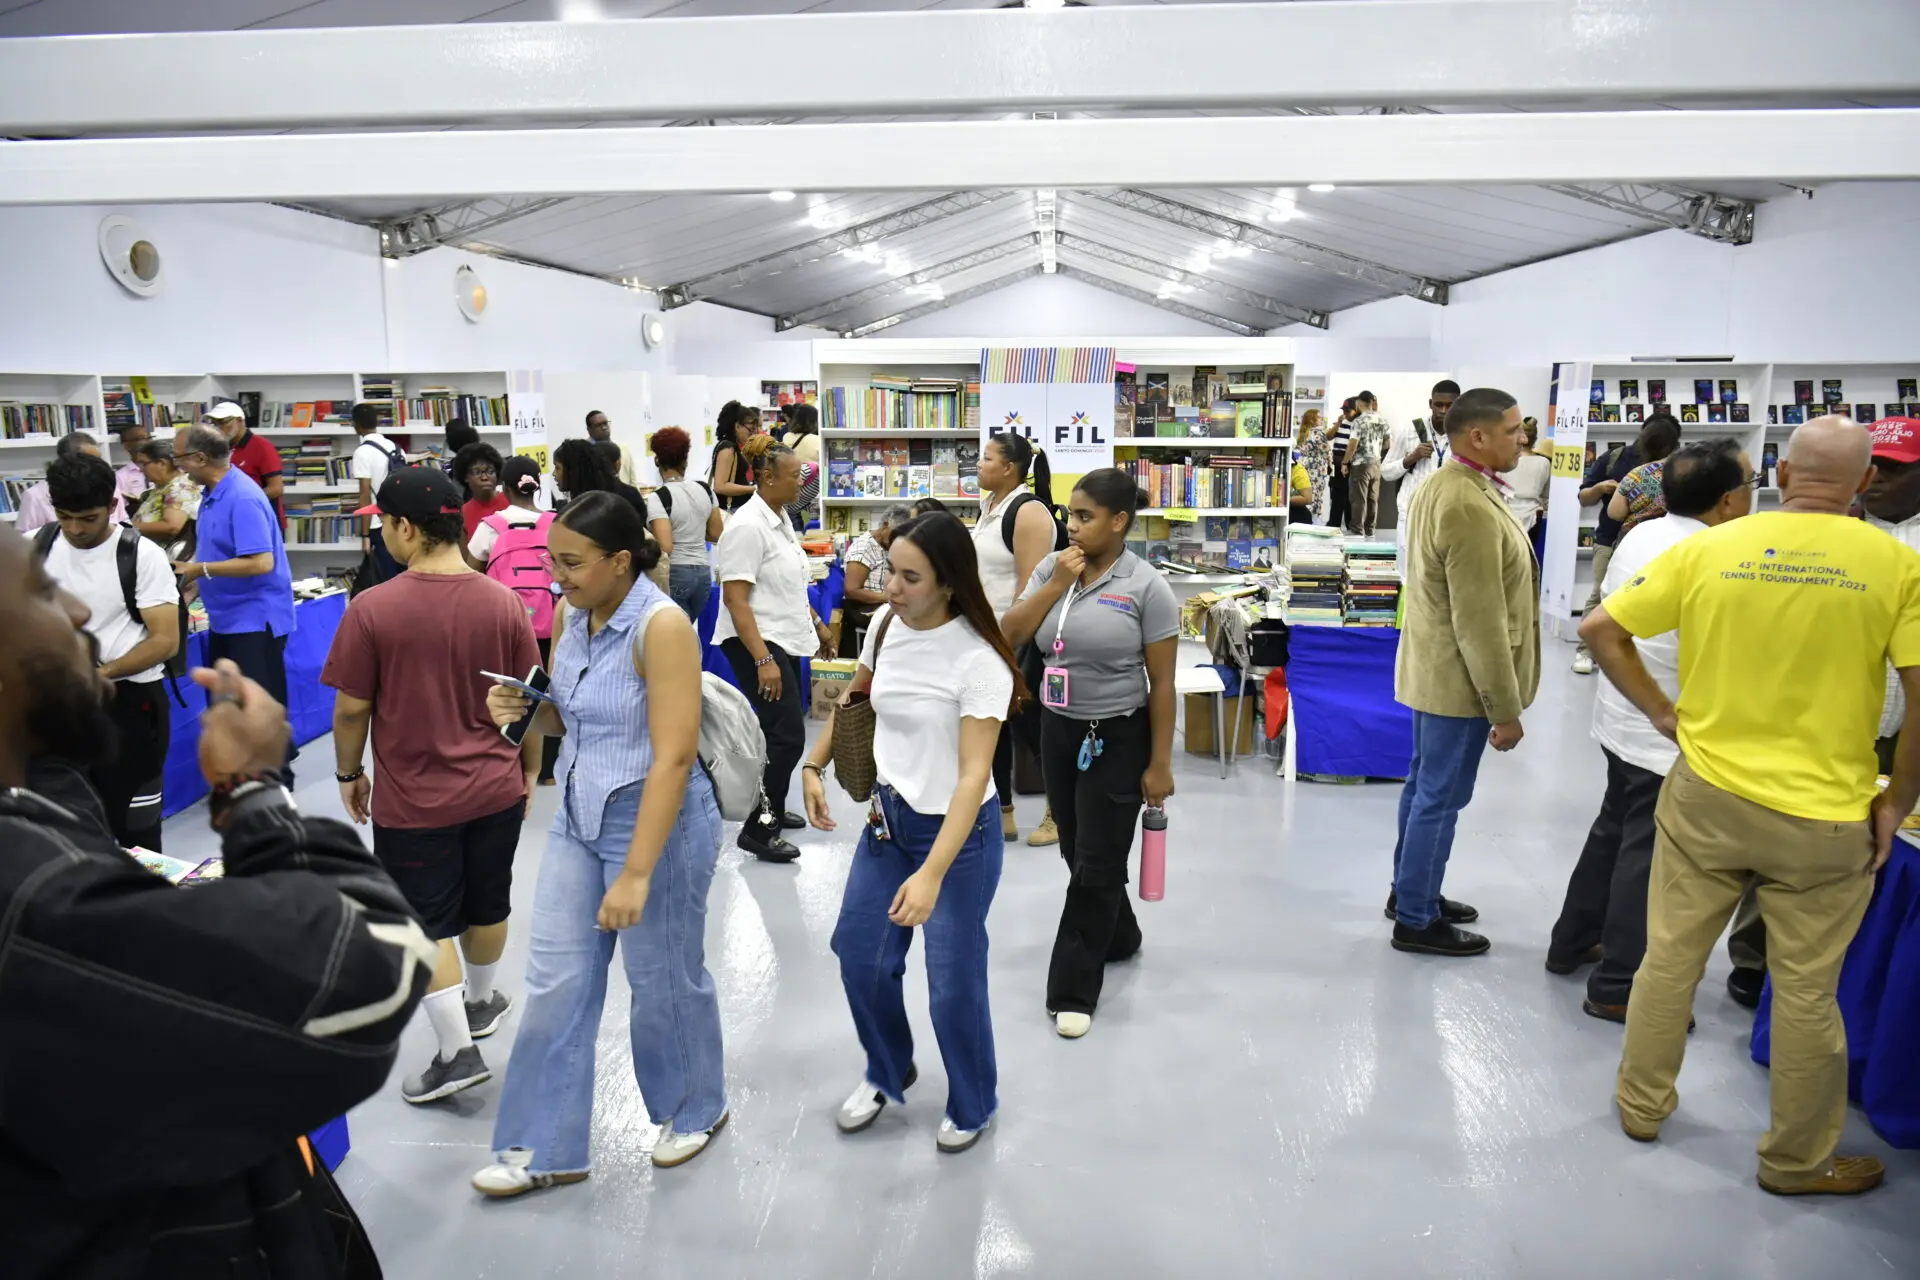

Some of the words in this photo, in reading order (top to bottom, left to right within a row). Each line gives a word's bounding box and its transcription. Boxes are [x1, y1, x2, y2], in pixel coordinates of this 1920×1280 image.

[515, 418, 528, 430] FIL
[532, 417, 545, 428] FIL
[1557, 416, 1568, 428] FIL
[1571, 416, 1584, 428] FIL
[1055, 426, 1105, 444] FIL
[1553, 452, 1565, 471] 37
[1568, 452, 1580, 472] 38
[1759, 562, 1849, 578] INTERNATIONAL
[1719, 571, 1756, 581] TENNIS
[1759, 572, 1836, 587] TOURNAMENT
